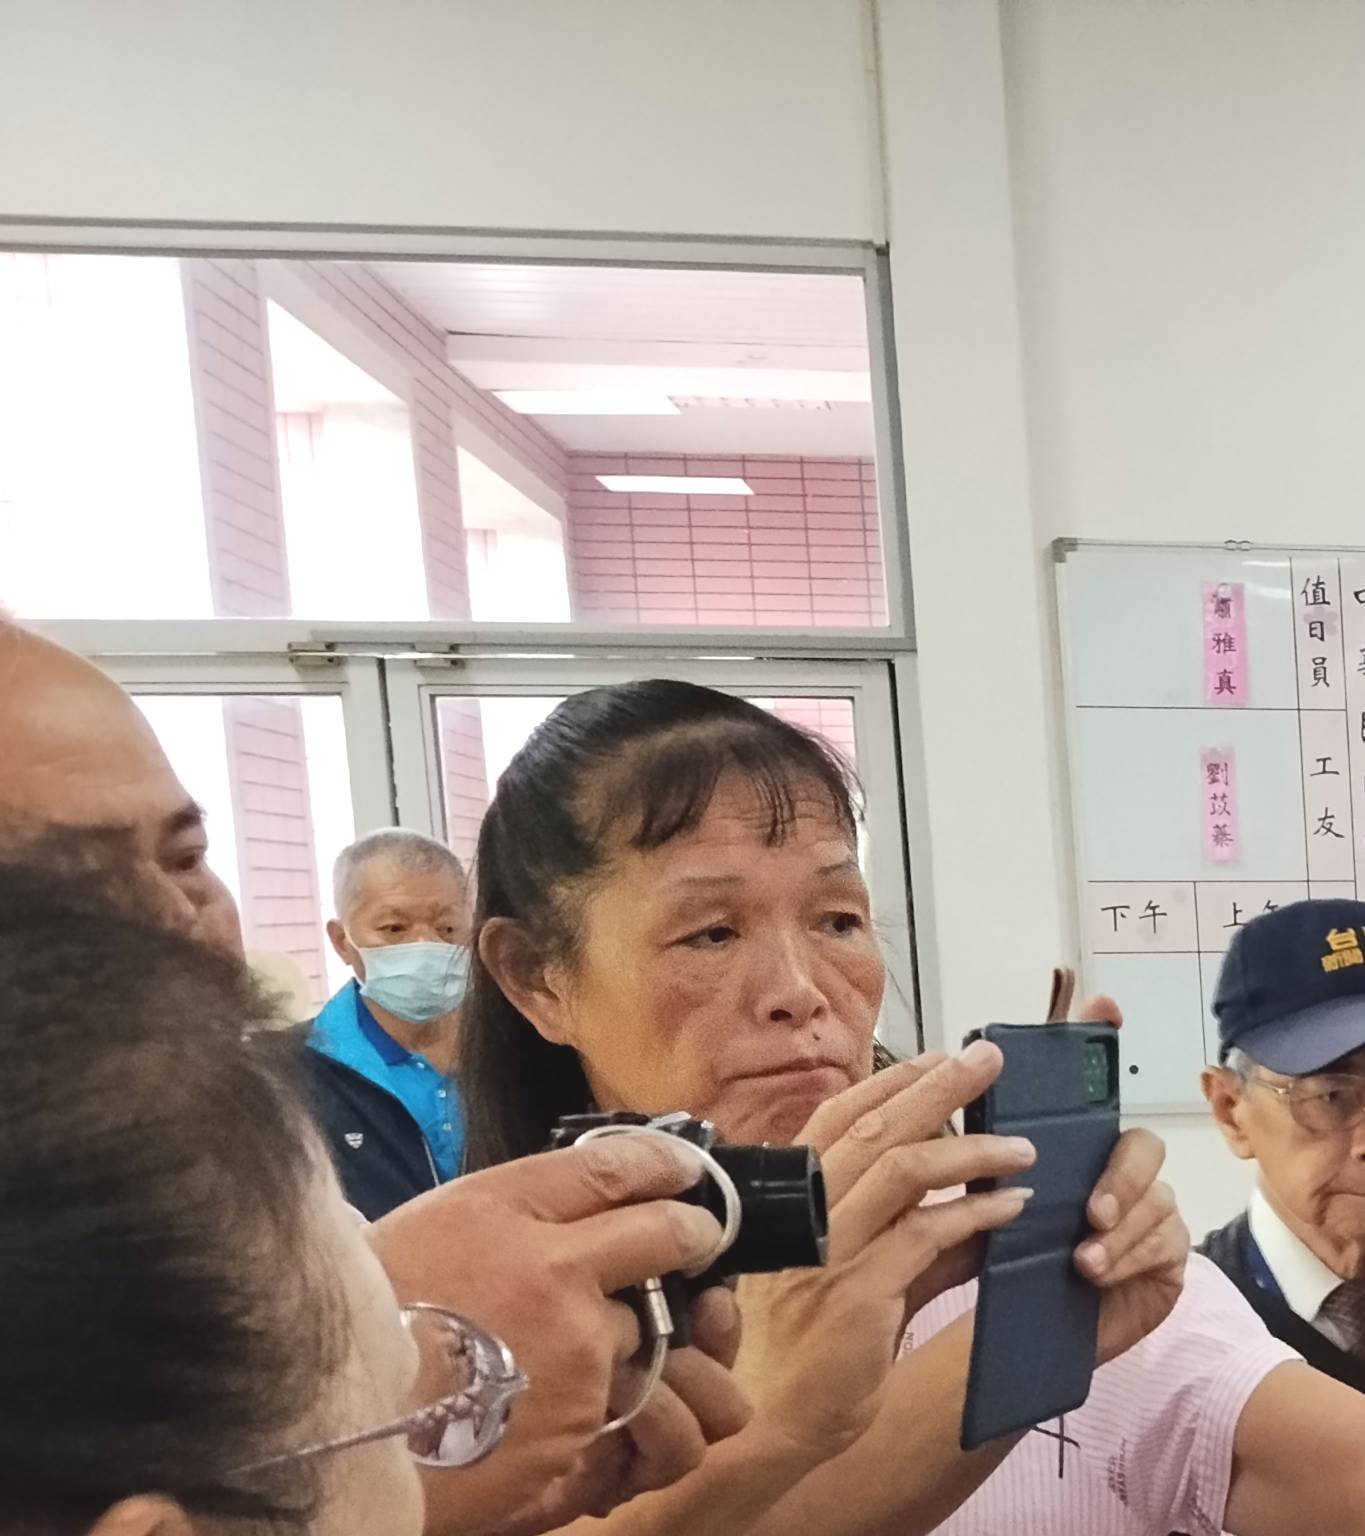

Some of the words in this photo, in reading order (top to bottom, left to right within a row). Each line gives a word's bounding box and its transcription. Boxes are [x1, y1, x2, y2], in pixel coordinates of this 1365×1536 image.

[1300, 574, 1331, 688] 值日員
[1309, 756, 1345, 839] 工友
[1101, 900, 1167, 934] 下午
